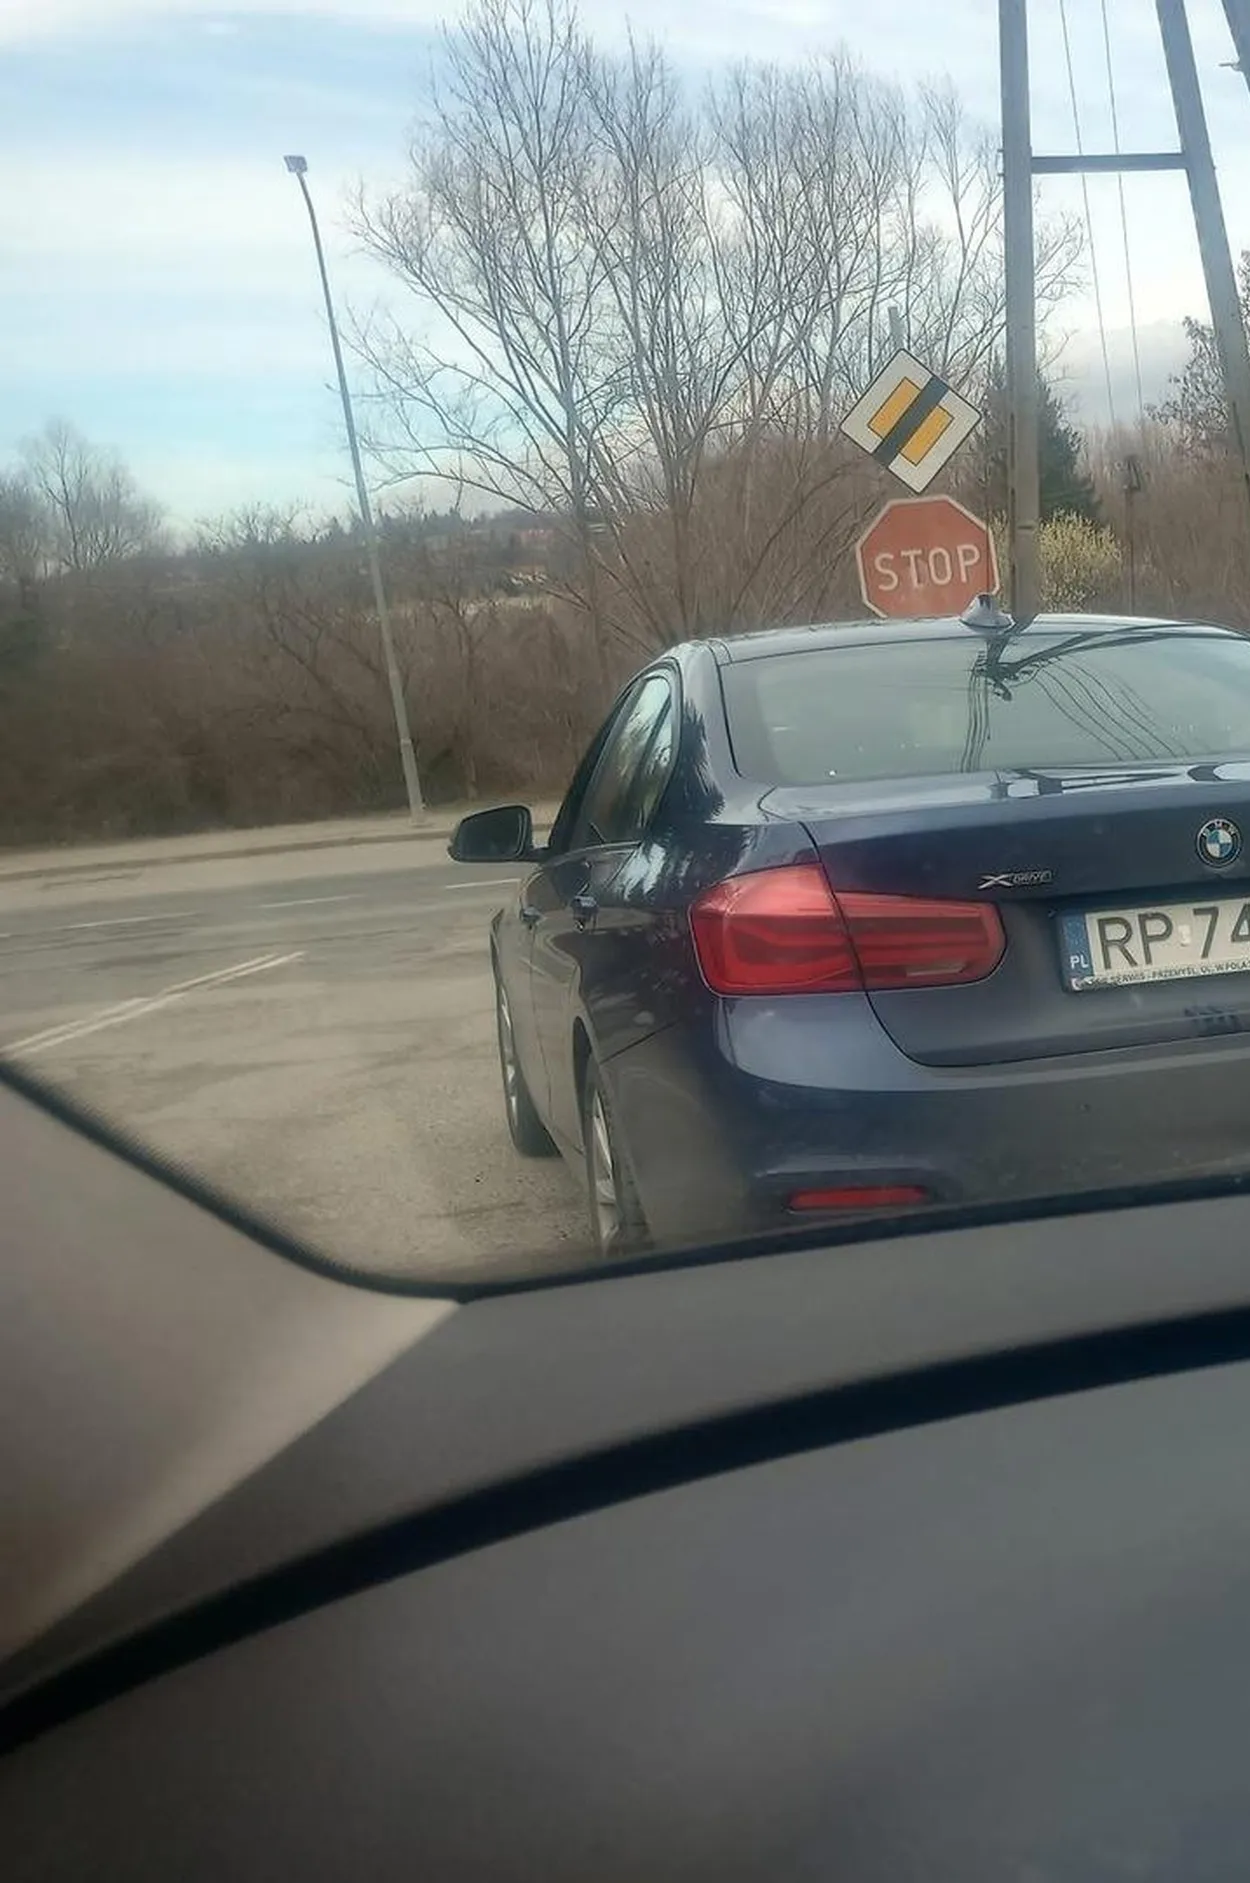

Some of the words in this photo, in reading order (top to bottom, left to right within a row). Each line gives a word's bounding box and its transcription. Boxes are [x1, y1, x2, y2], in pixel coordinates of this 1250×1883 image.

[874, 544, 981, 591] STOP
[1069, 955, 1089, 969] PL
[1096, 911, 1173, 970] RP
